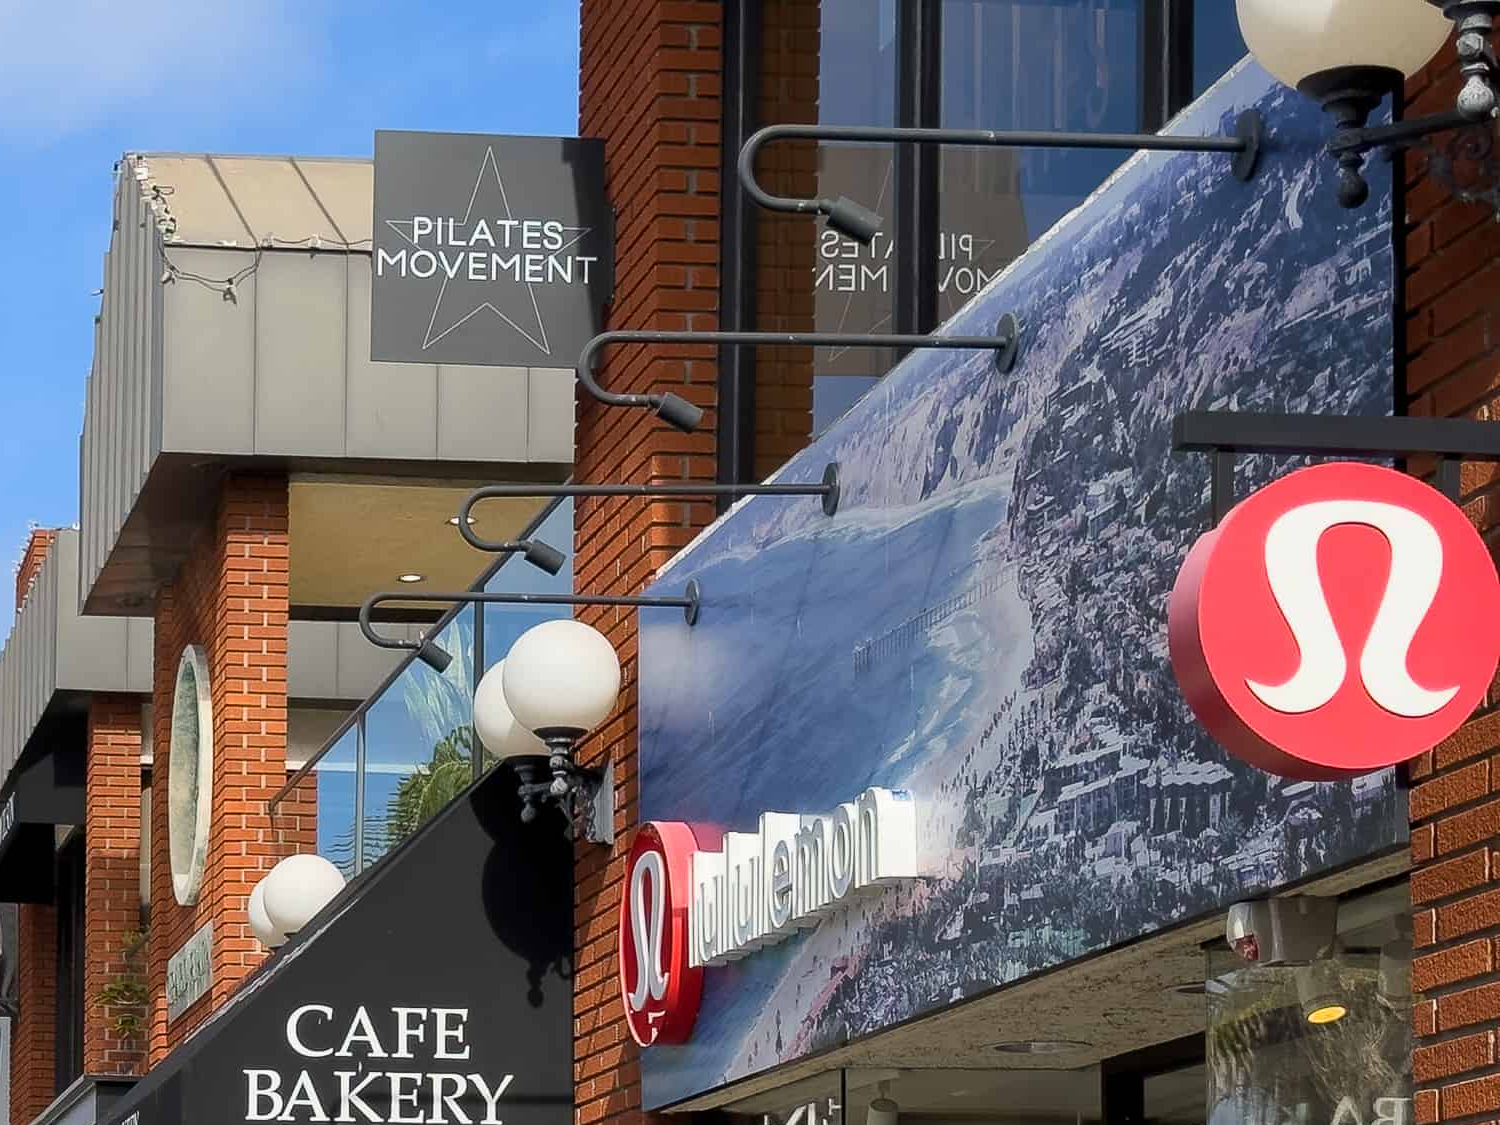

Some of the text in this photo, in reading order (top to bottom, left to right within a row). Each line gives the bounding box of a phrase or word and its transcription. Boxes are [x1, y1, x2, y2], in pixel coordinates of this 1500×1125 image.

[412, 215, 565, 250] PILATES
[376, 248, 598, 284] MOVEMENT
[687, 786, 910, 968] lululemon
[286, 1004, 471, 1060] CAFE
[243, 1069, 514, 1125] BAKERY
